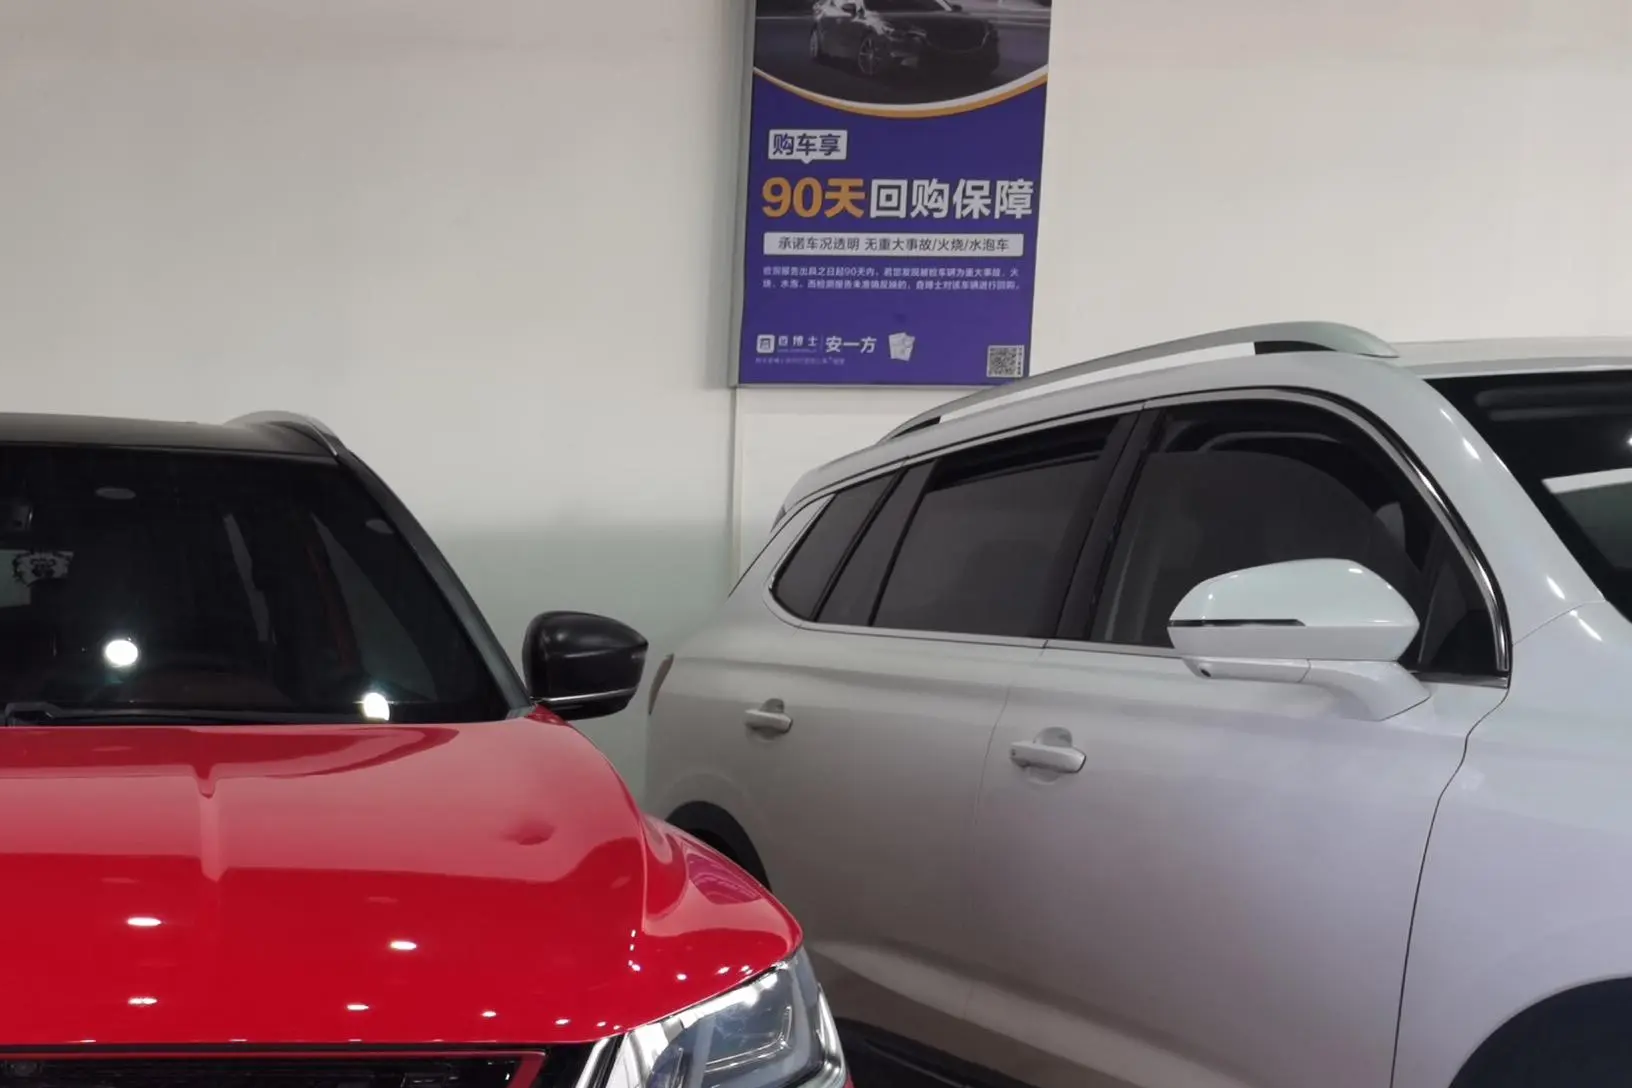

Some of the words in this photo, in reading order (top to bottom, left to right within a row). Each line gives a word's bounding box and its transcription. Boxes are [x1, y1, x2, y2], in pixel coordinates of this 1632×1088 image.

[772, 132, 841, 157] 购车享
[762, 176, 1034, 220] 90天回购保障
[778, 236, 859, 252] 承诺车况透明
[864, 237, 1009, 253] 无重大事故/火烧/水泡车
[825, 335, 877, 353] 安一方
